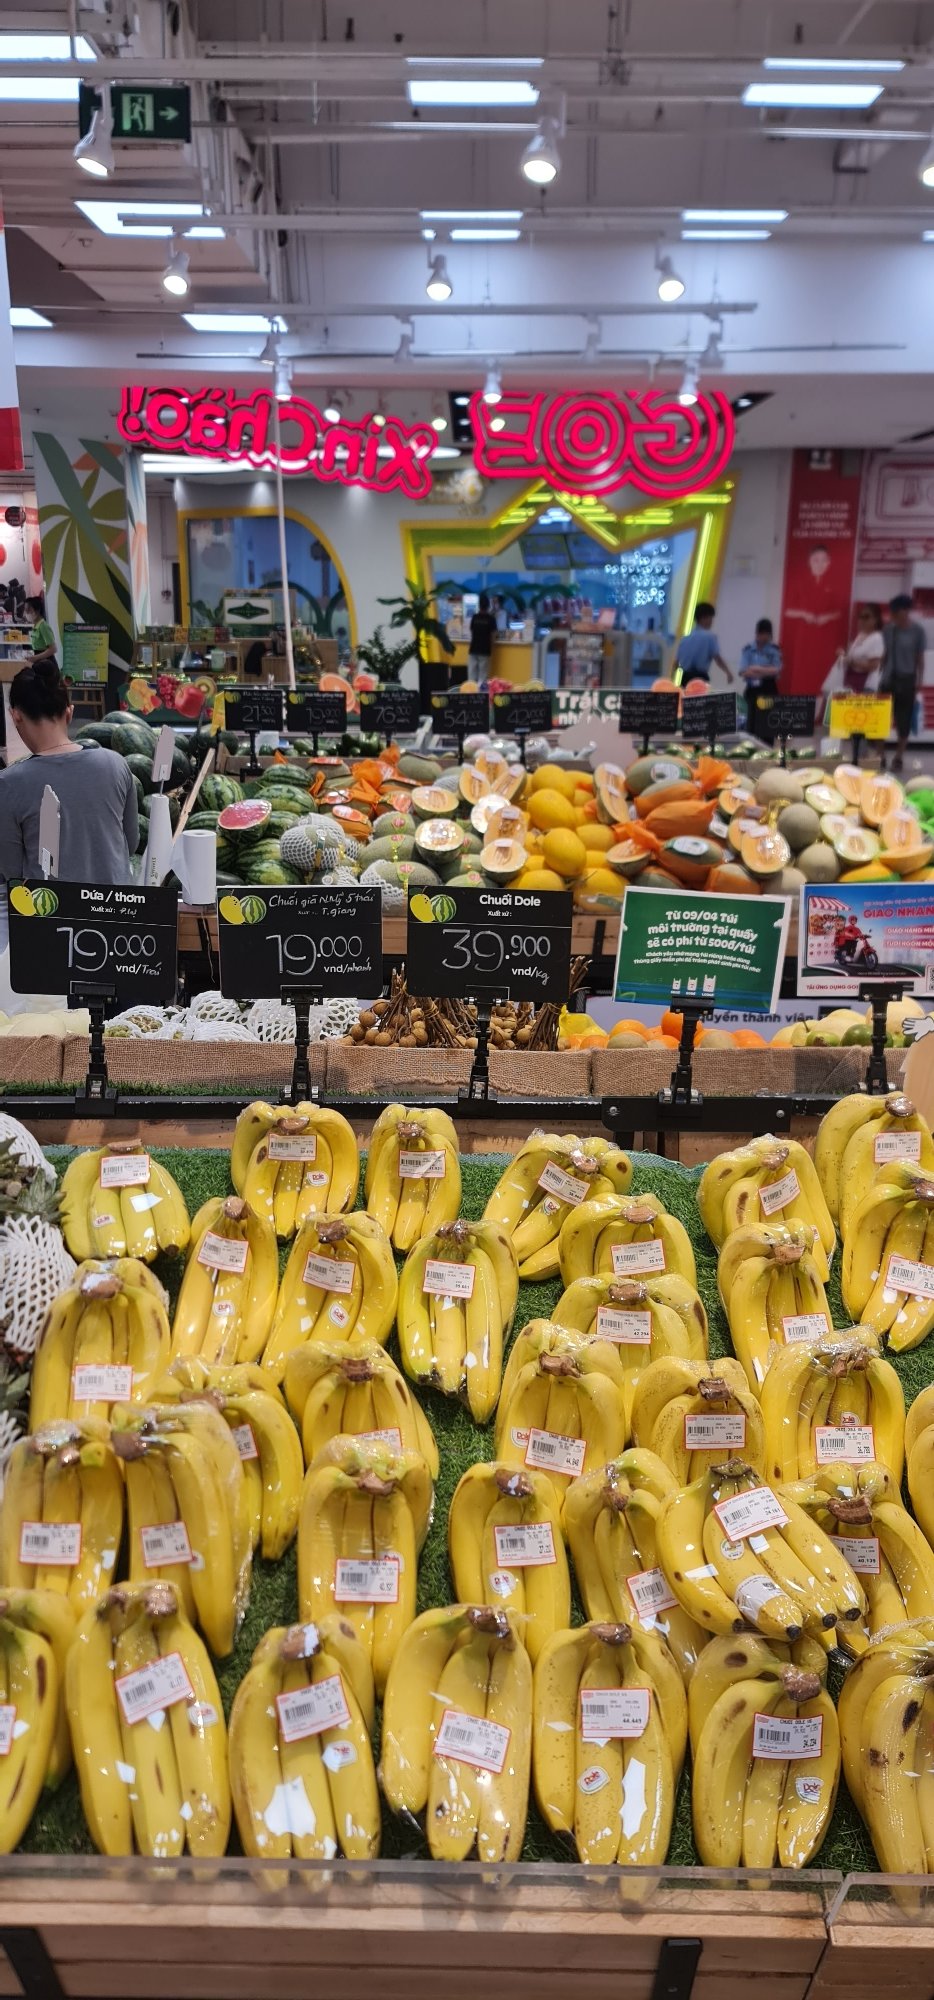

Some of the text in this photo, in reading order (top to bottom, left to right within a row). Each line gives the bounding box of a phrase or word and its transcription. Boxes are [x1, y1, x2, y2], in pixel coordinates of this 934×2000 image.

[81, 889, 146, 904] Dứa / thơm
[479, 894, 541, 907] Chuối Dole
[682, 911, 718, 922] 09/04
[720, 913, 738, 924] Túi
[863, 907, 894, 919] GIAO
[648, 923, 669, 934] môi
[712, 924, 728, 936] tại
[662, 936, 674, 947] có
[57, 927, 156, 972] 19.000
[266, 934, 363, 976] 19.000
[442, 929, 551, 972] 39.900
